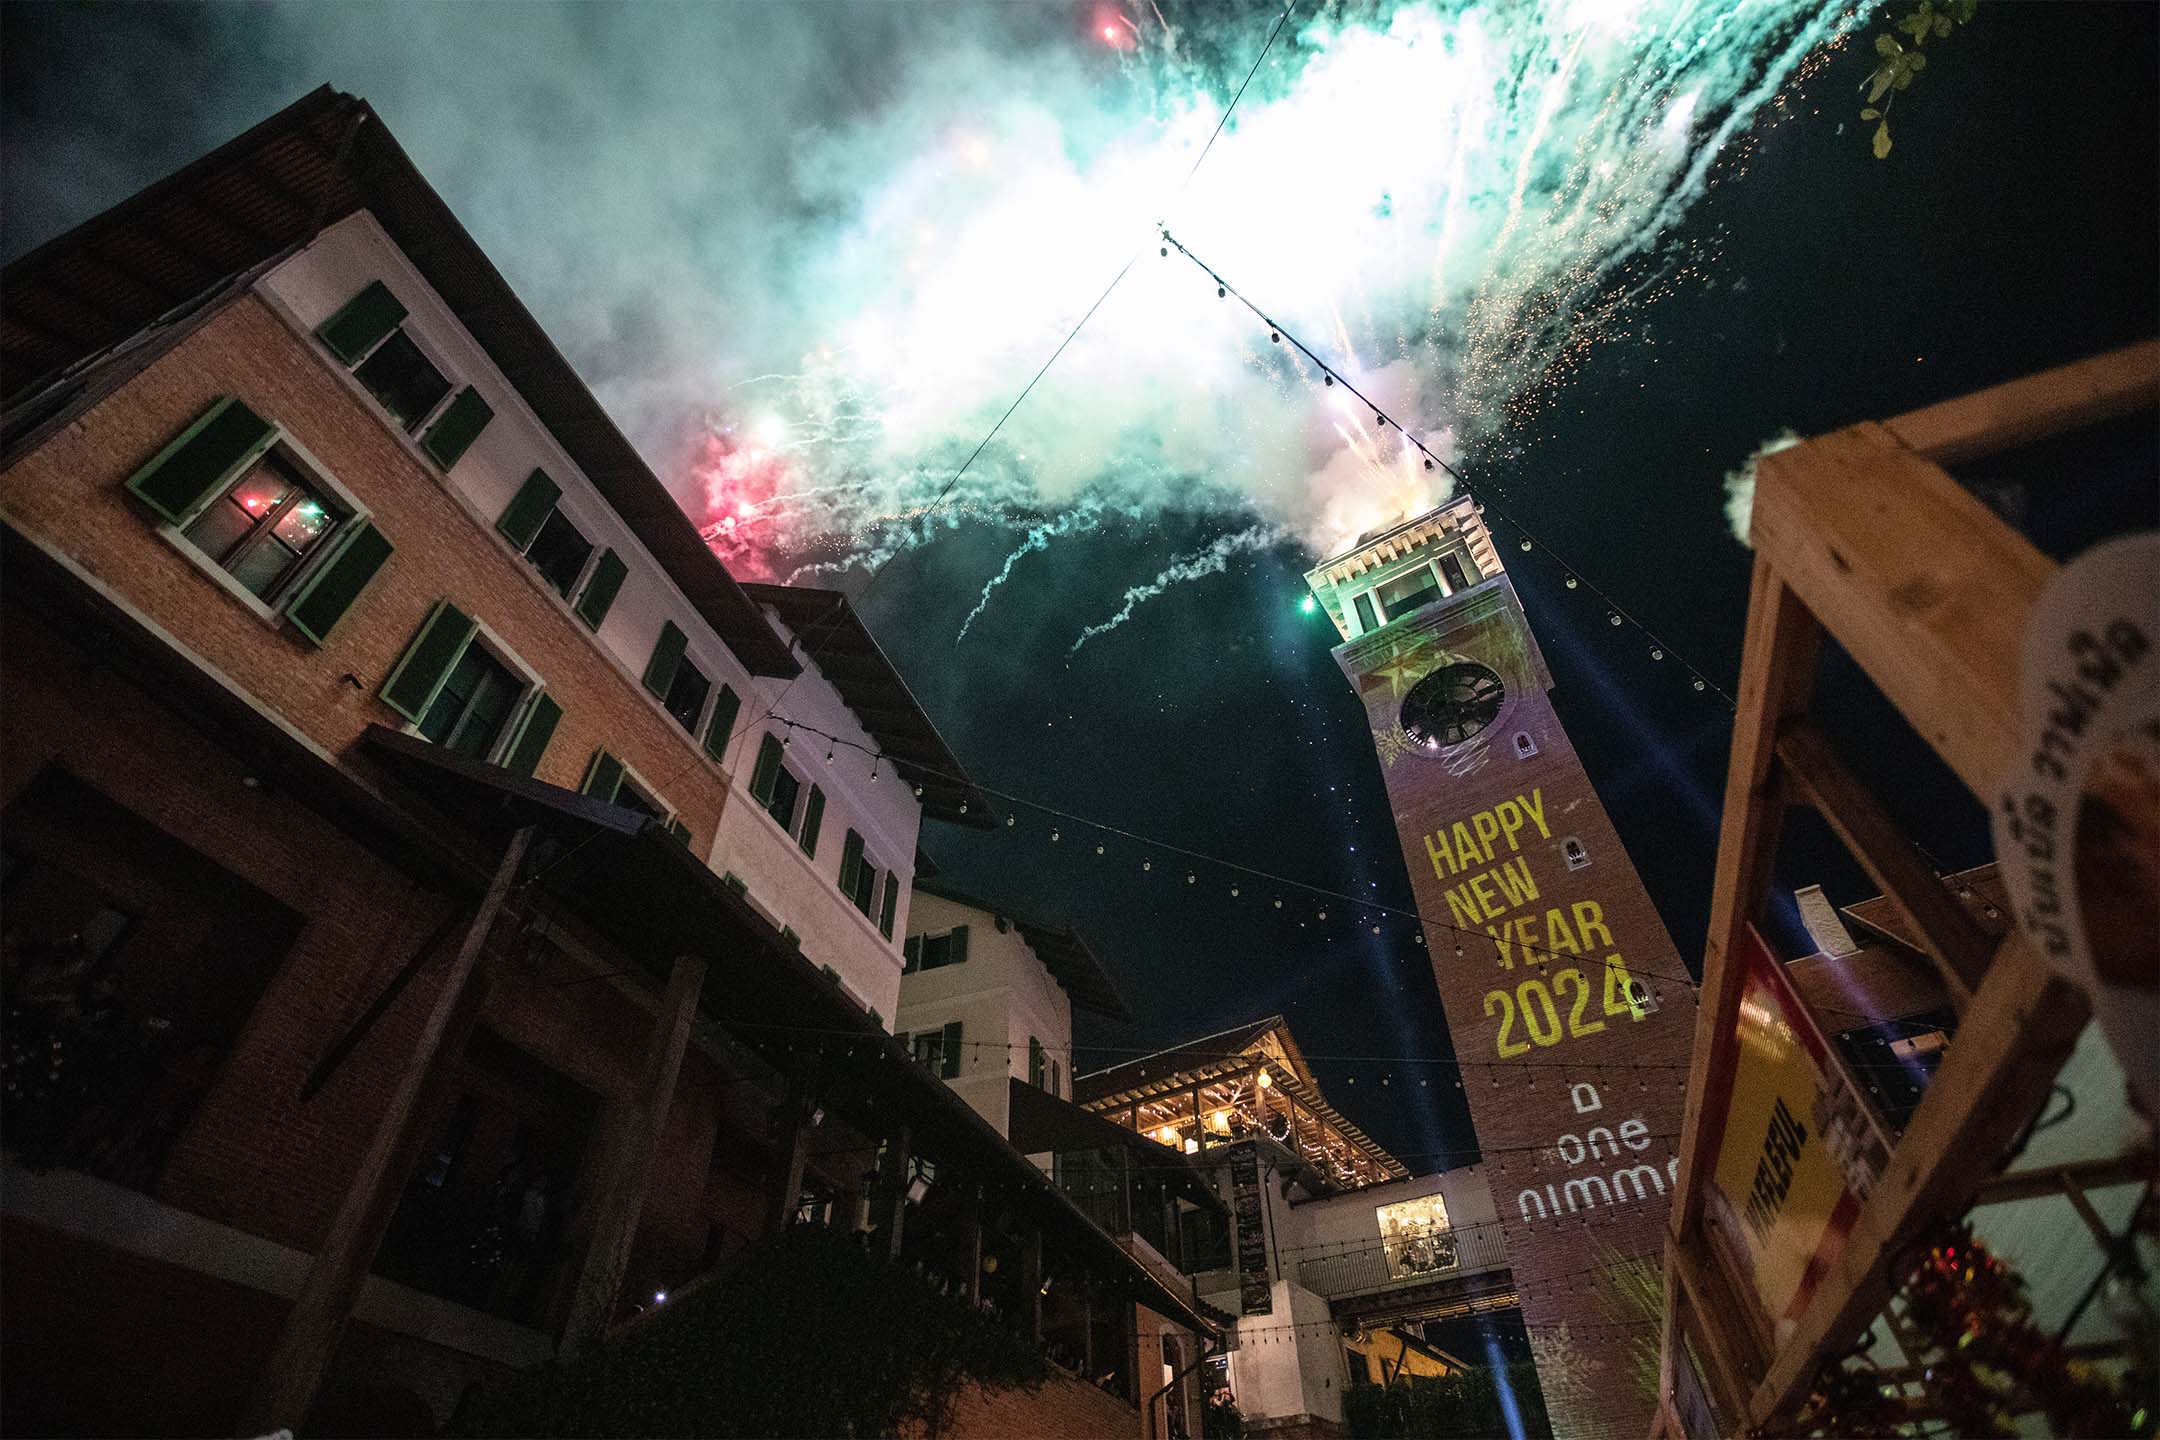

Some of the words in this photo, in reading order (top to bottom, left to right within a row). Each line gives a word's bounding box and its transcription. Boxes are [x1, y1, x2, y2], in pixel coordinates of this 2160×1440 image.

[1424, 787, 1552, 880] HAPPY
[1444, 855, 1541, 929] NEW
[1486, 900, 1615, 970] YEAR
[1483, 953, 1647, 1059] 2024
[1558, 1119, 1652, 1165] one
